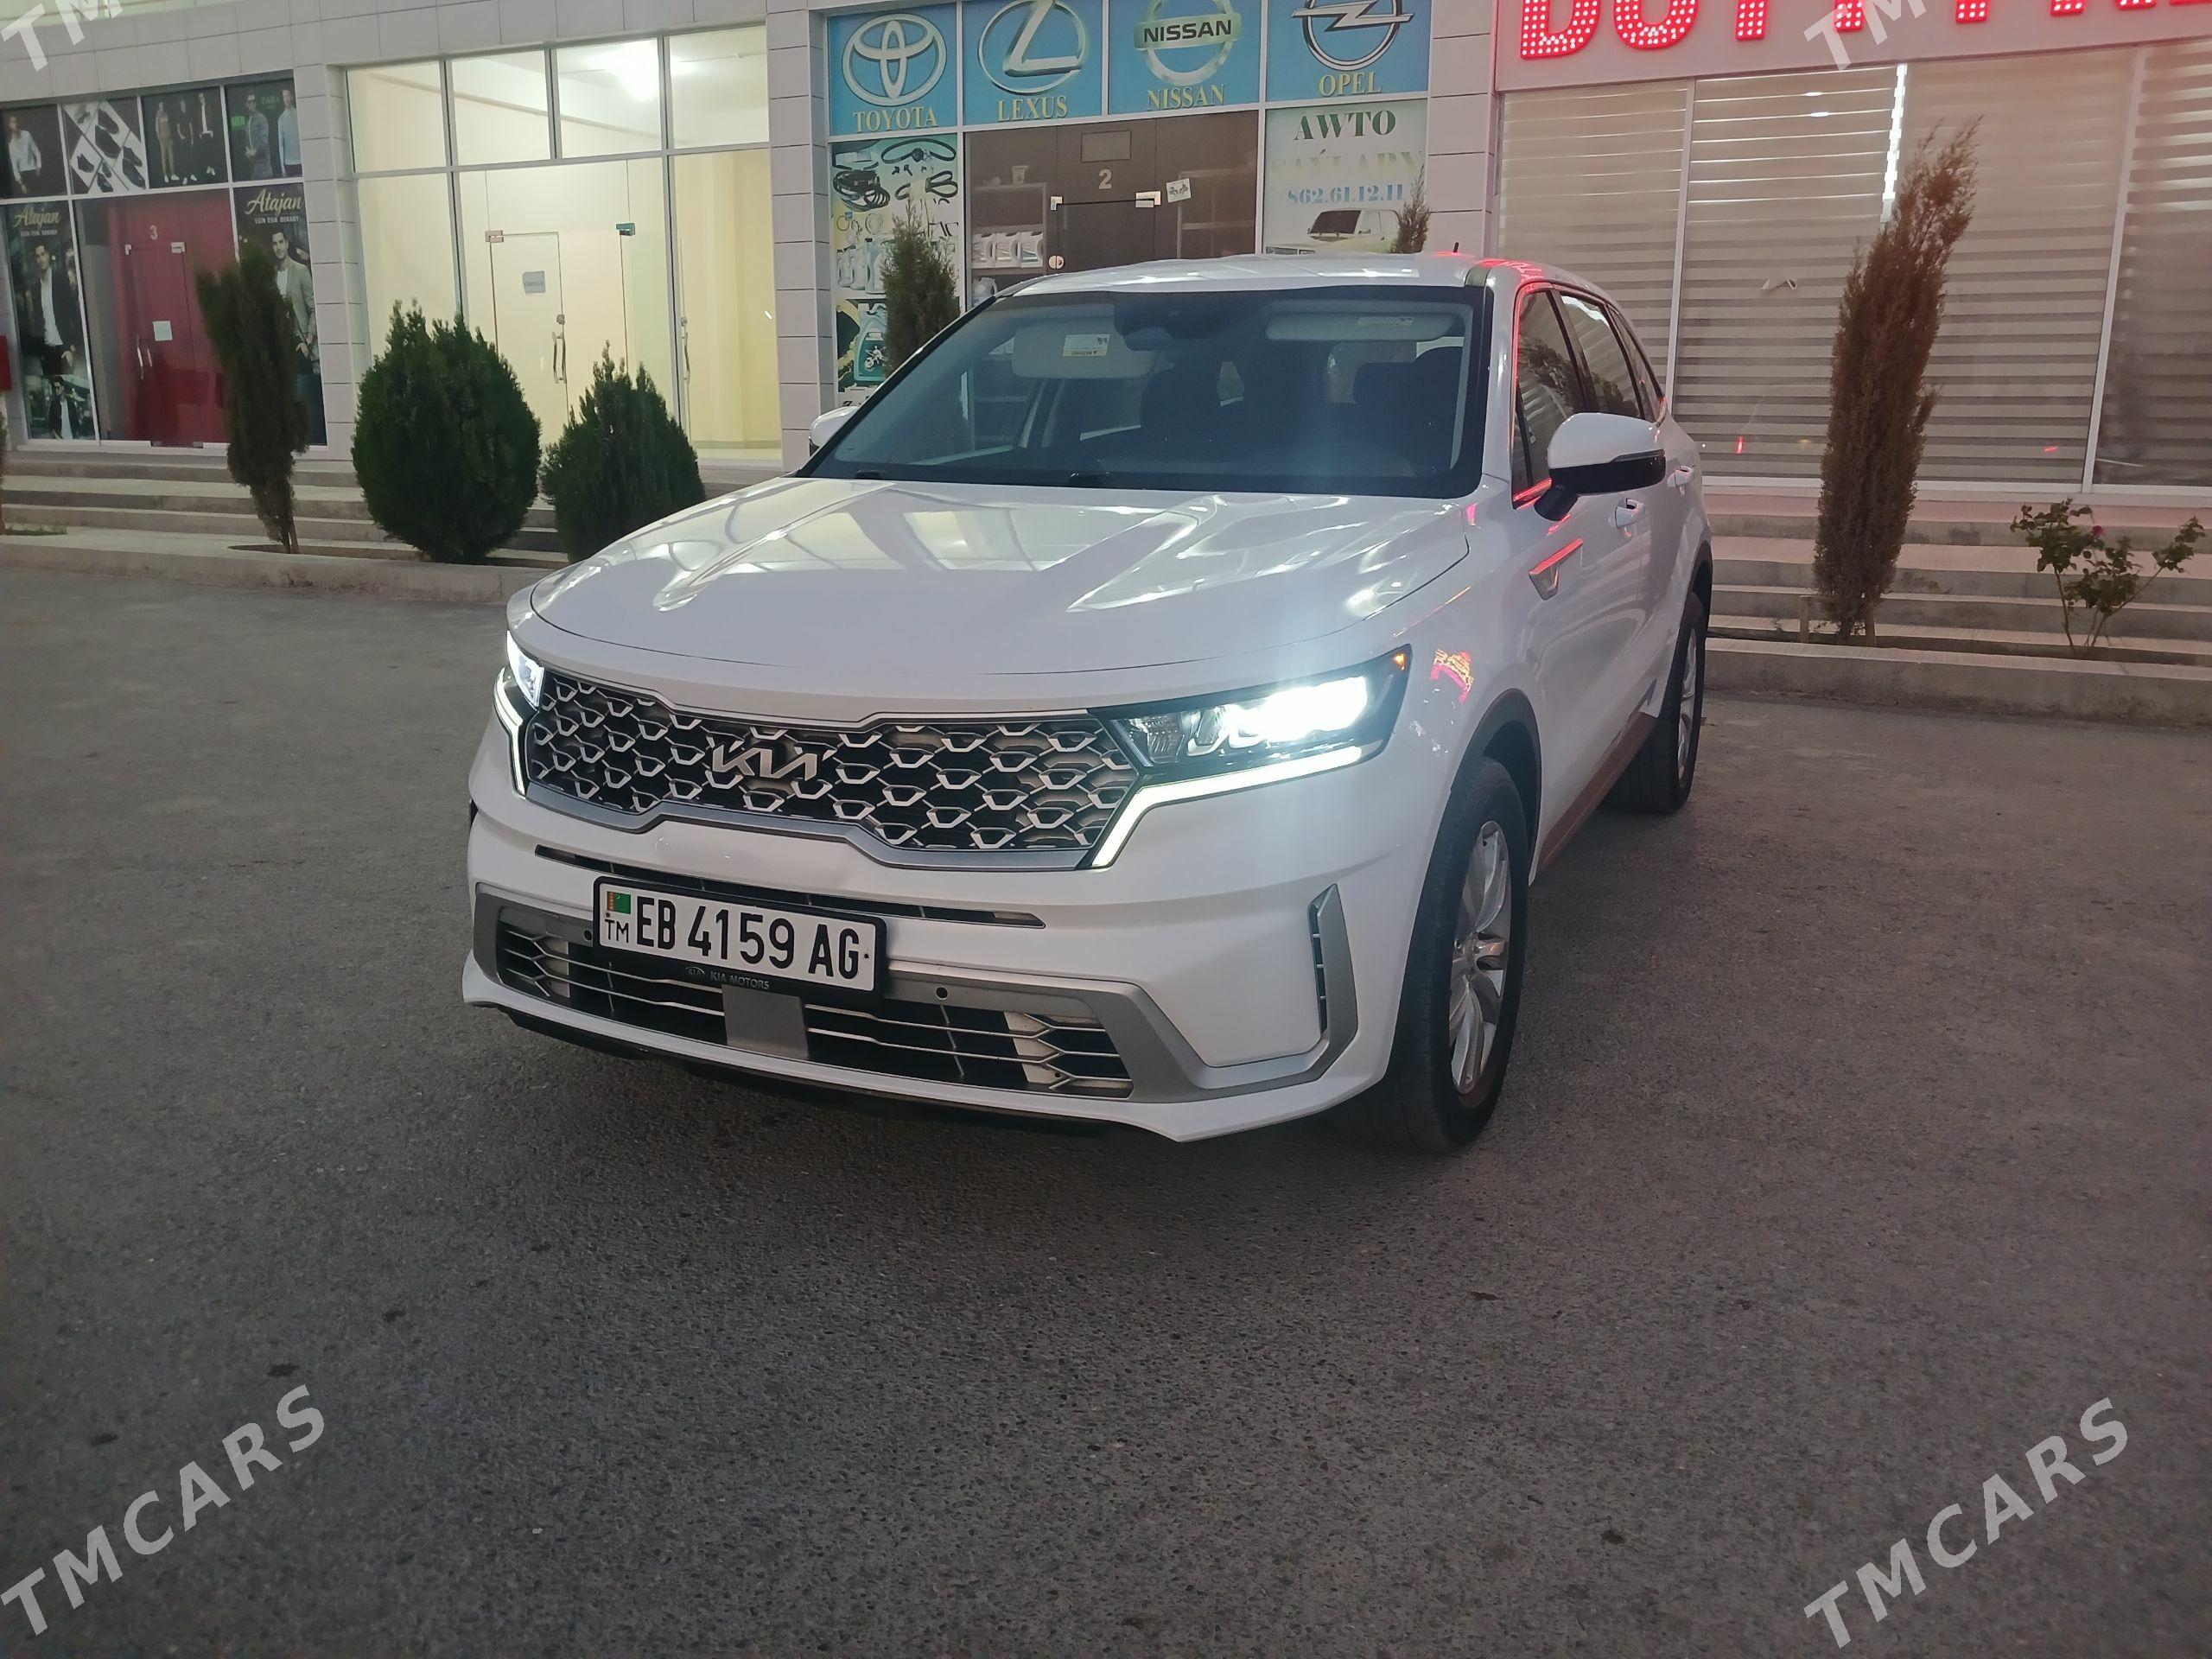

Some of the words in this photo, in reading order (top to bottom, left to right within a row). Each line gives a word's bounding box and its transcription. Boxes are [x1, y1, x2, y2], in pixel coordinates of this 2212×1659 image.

[1144, 19, 1231, 42] NISSAN
[1147, 84, 1225, 111] NISSAN
[1319, 71, 1382, 98] OPEL
[853, 105, 939, 133] TOYOTA
[997, 95, 1068, 123] LEXUS
[1293, 110, 1396, 141] AWTO
[1098, 169, 1112, 189] 2
[245, 188, 302, 216] Atajan
[13, 206, 61, 230] Atajan
[149, 225, 158, 240] 3
[605, 918, 629, 944] TM
[636, 895, 676, 950] EB
[688, 906, 795, 969] 4159
[808, 924, 860, 980] AG
[710, 970, 728, 982] KIA
[729, 975, 770, 990] MOTORS
